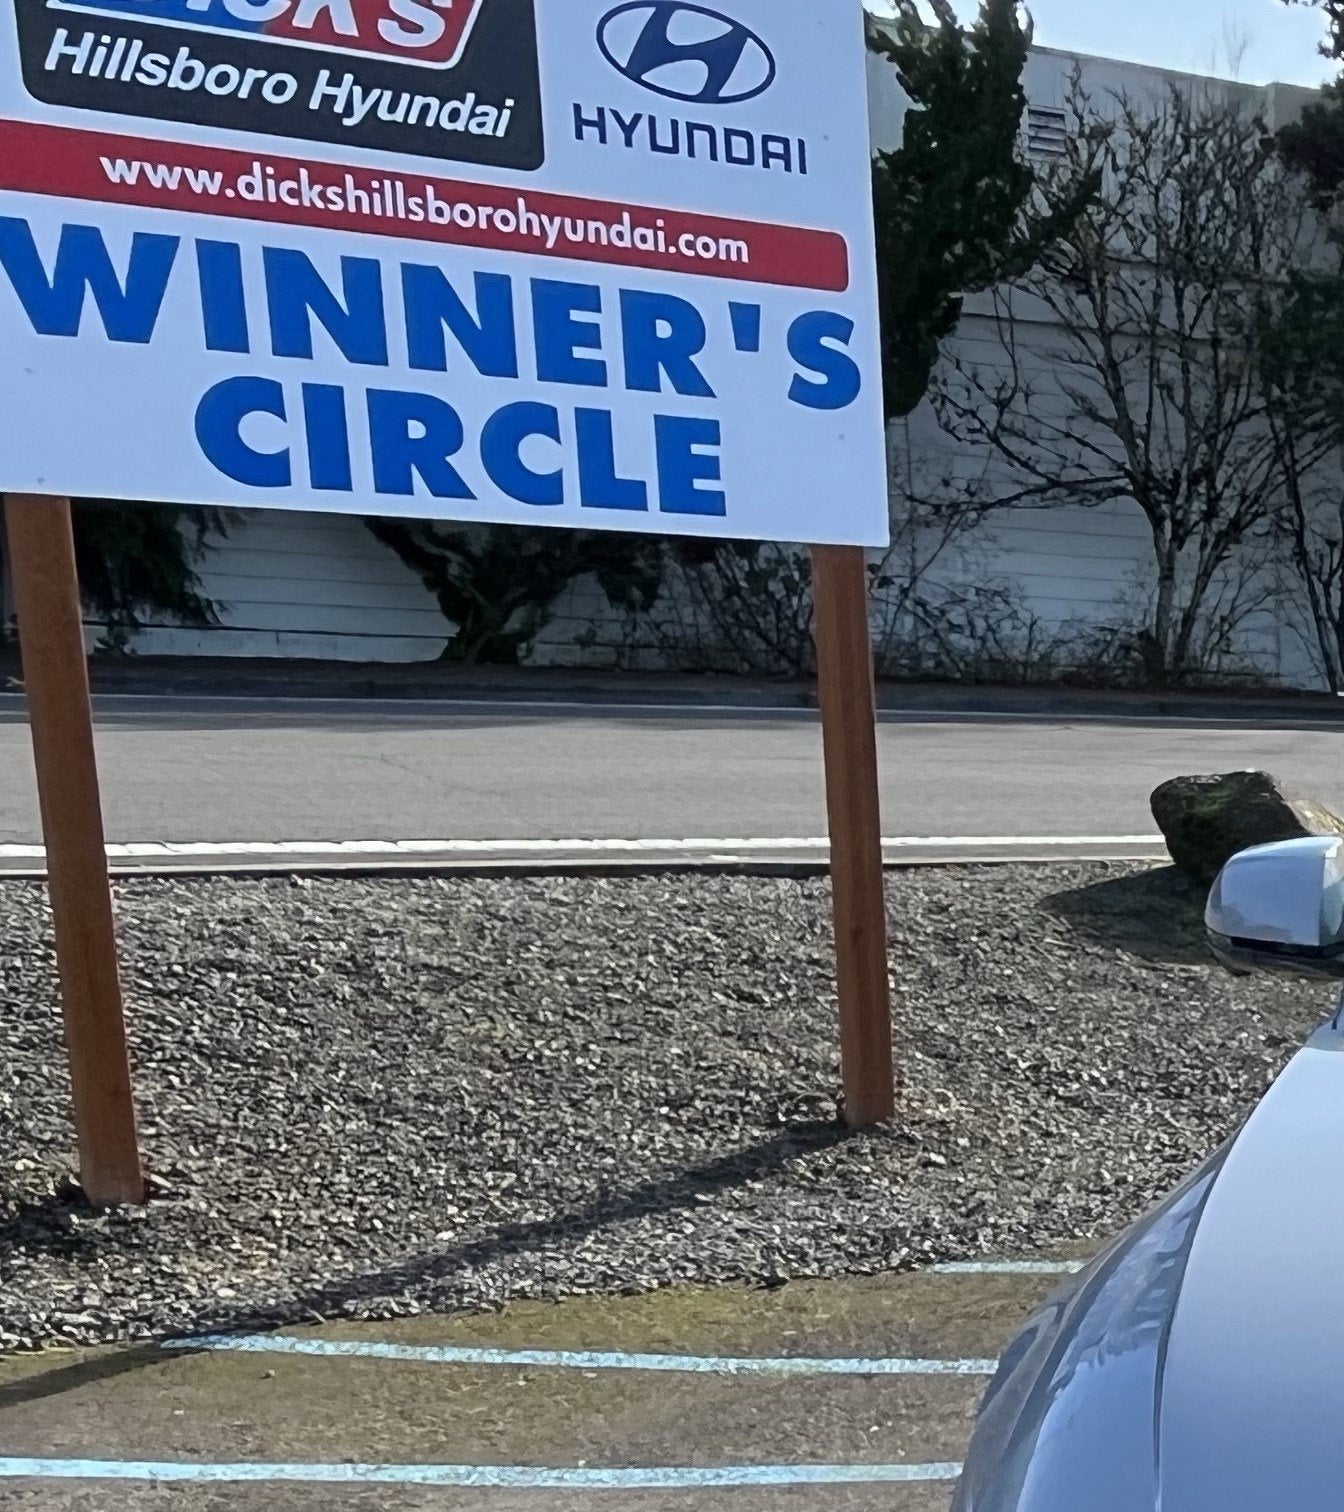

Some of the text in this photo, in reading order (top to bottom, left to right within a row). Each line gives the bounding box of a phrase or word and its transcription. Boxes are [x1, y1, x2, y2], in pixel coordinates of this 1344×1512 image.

[45, 28, 514, 138] Hillsboro Hyundai
[573, 103, 807, 175] HYUNDAI
[100, 155, 749, 264] www.dickshillsborohyundai.com
[2, 217, 861, 410] WINNER'S
[195, 376, 726, 517] CIRCLE
